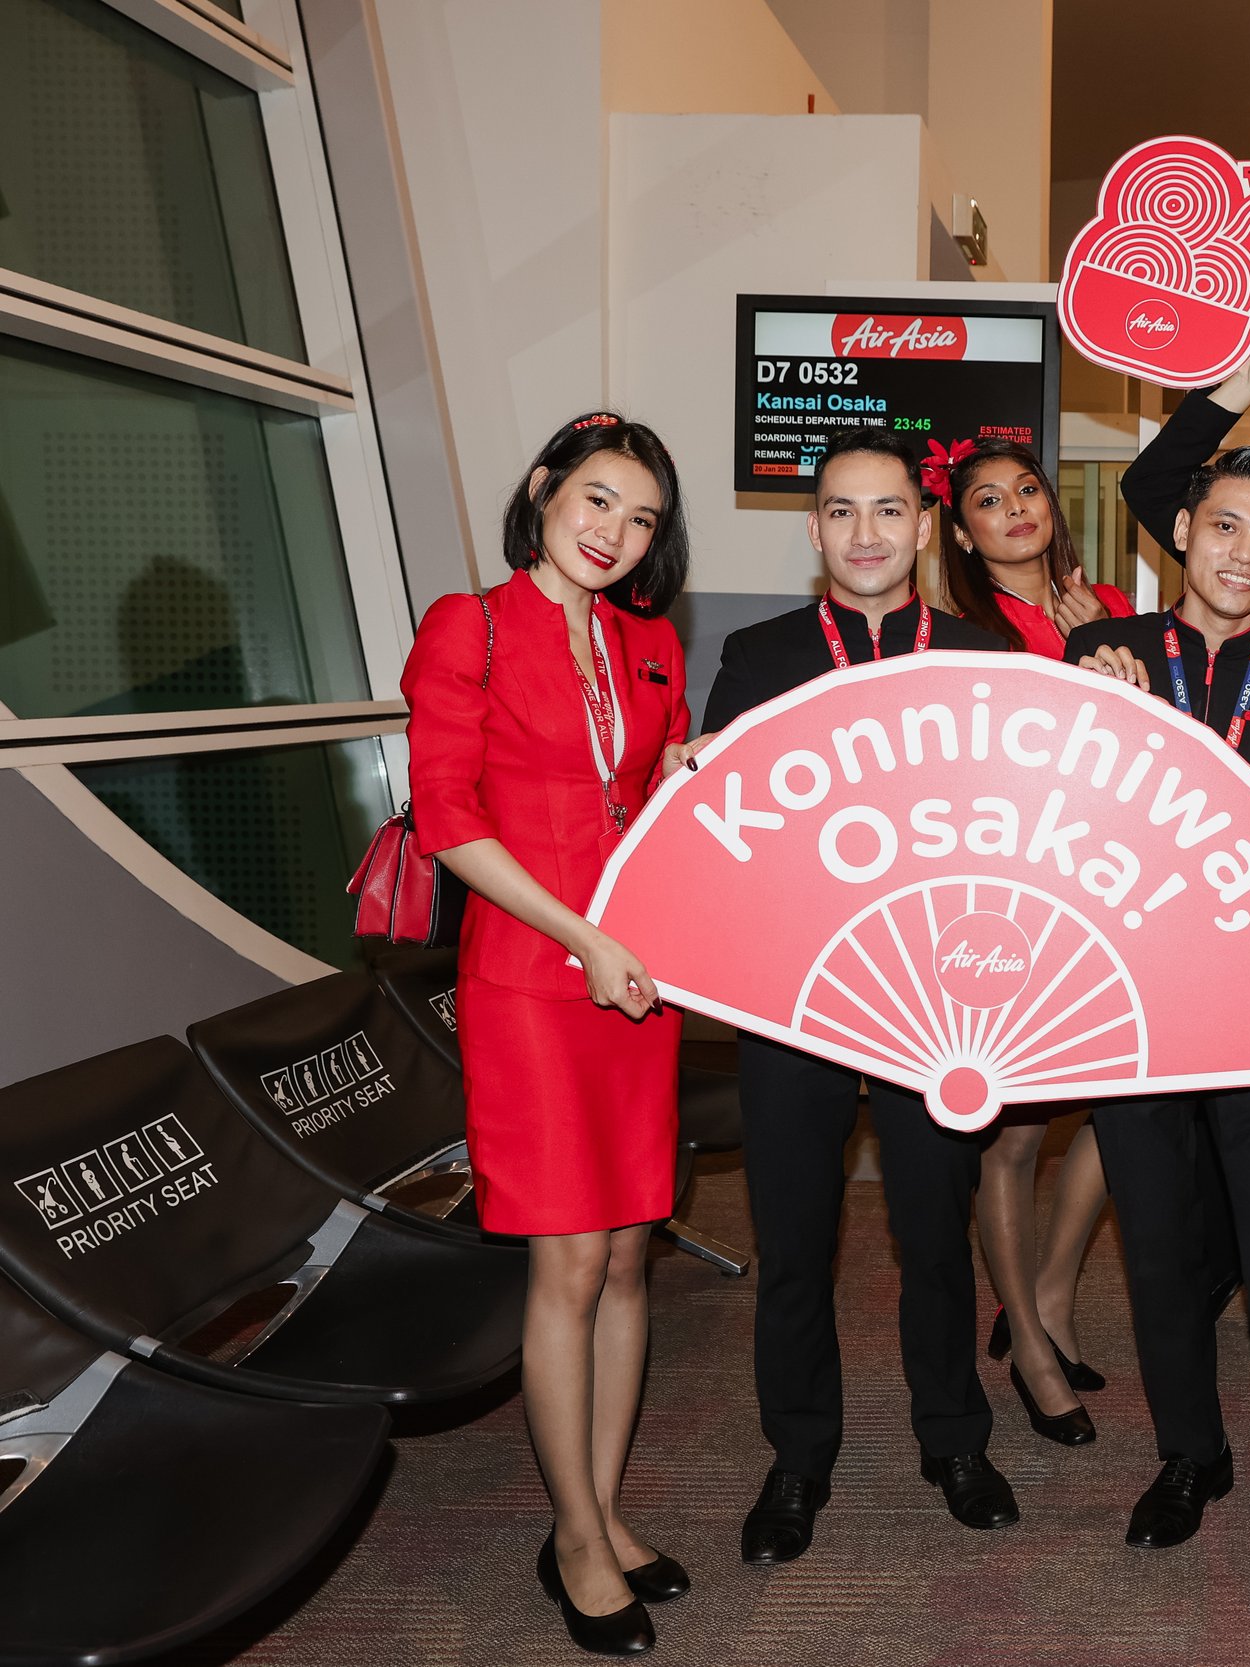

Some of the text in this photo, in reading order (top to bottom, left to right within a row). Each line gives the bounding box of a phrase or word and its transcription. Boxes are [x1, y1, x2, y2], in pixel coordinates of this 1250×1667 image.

[1129, 313, 1175, 334] AirAsia
[841, 317, 957, 357] AirAsia
[757, 361, 858, 385] D7 0532
[757, 392, 887, 412] Kansai Osaka
[754, 415, 887, 426] SCHEDULE DEPARTURE TIME:
[894, 417, 931, 431] 23:45
[980, 426, 1032, 435] ESTIMATED
[754, 433, 829, 443] BOARDING TIME:
[754, 450, 796, 459] REMARK:
[919, 621, 929, 637] ONE
[830, 640, 842, 657] ALL
[597, 659, 607, 676] ALL
[583, 682, 597, 702] ONE
[592, 702, 605, 723] FOR
[598, 723, 610, 743] ALL
[818, 788, 1188, 930] Osaka!
[940, 940, 1026, 978] AirAsia
[291, 1074, 397, 1139] PRIORITY SEAT
[55, 1163, 219, 1260] PRIORITY SEAT
